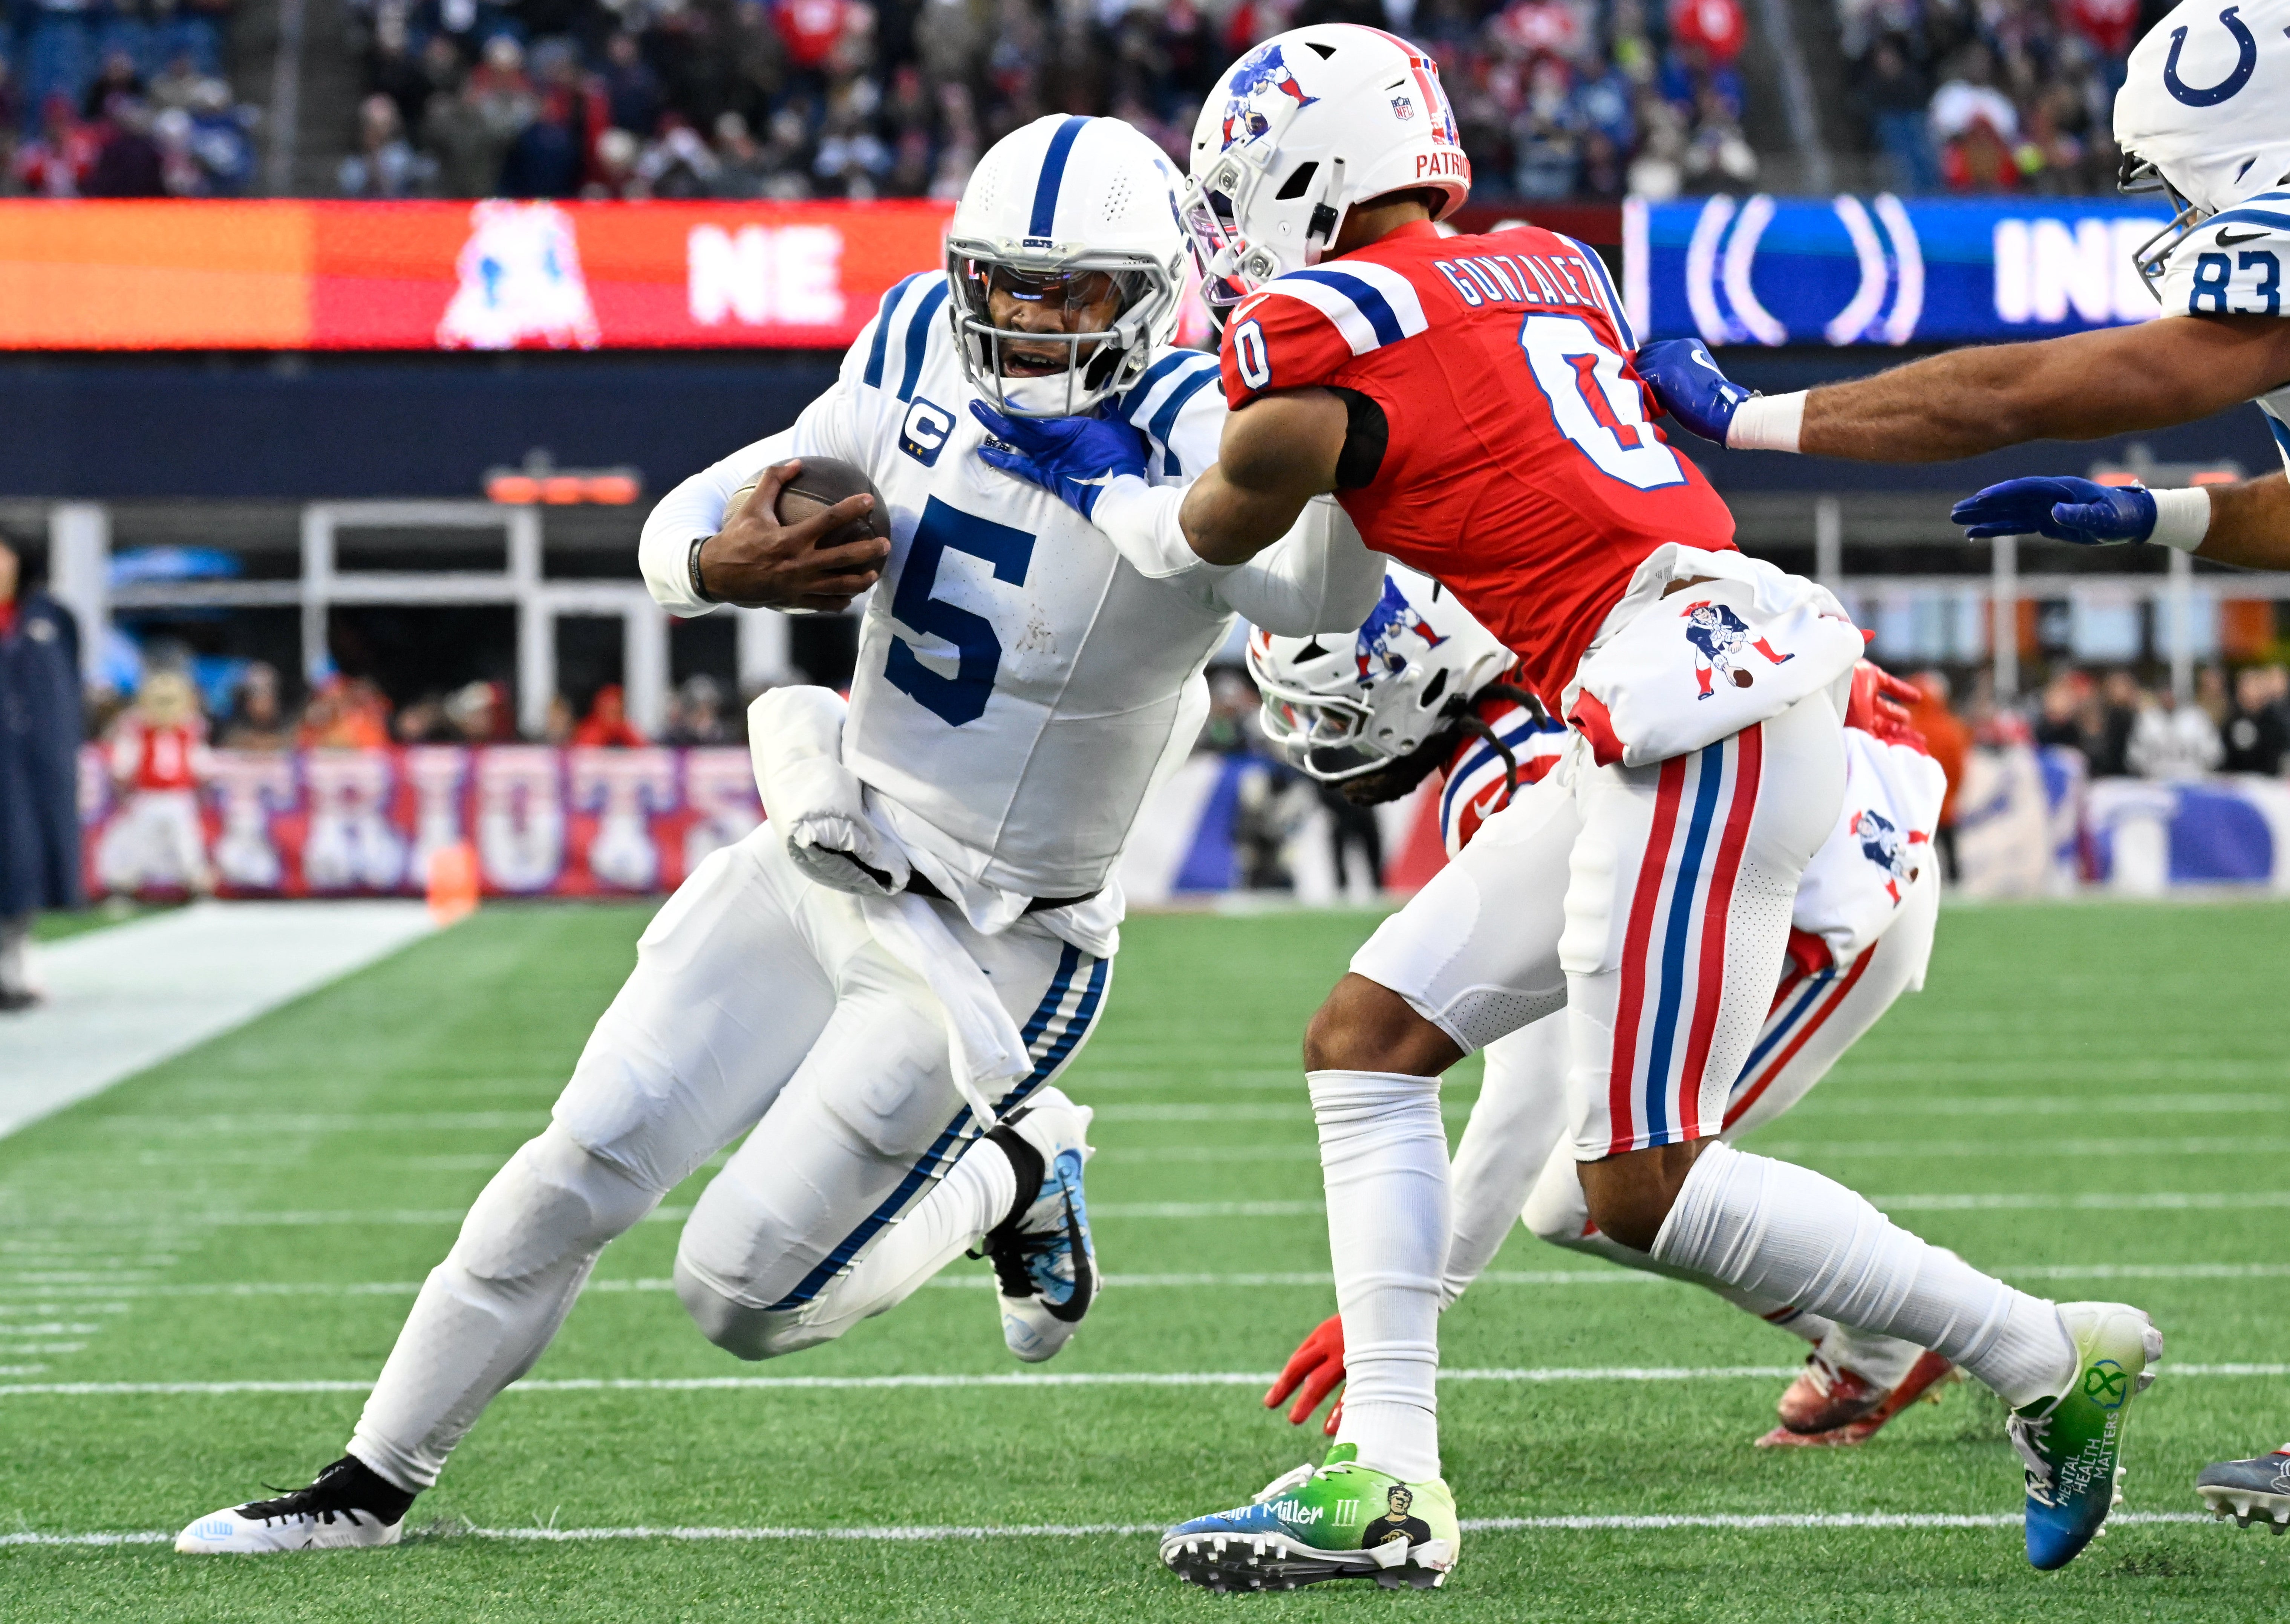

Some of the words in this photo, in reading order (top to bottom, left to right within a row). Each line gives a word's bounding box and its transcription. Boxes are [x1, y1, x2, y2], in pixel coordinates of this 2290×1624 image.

[1396, 106, 1412, 118] NFL
[1416, 152, 1471, 182] PATRIO
[1022, 239, 1053, 249] COLTS
[688, 223, 844, 326] NE
[1433, 254, 1603, 307] GONZALEZ
[2188, 250, 2280, 317] 83
[1233, 318, 1272, 391] 0
[905, 402, 949, 449] C
[1517, 312, 1689, 492] 0
[884, 494, 1036, 727] 5
[77, 746, 765, 889] TRIOTS
[2073, 1439, 2101, 1494] HEALTH
[2093, 1412, 2119, 1479] MATTERS
[2056, 1454, 2080, 1507] MENTAL
[1263, 1499, 1324, 1525] Miller
[1332, 1499, 1360, 1526] III
